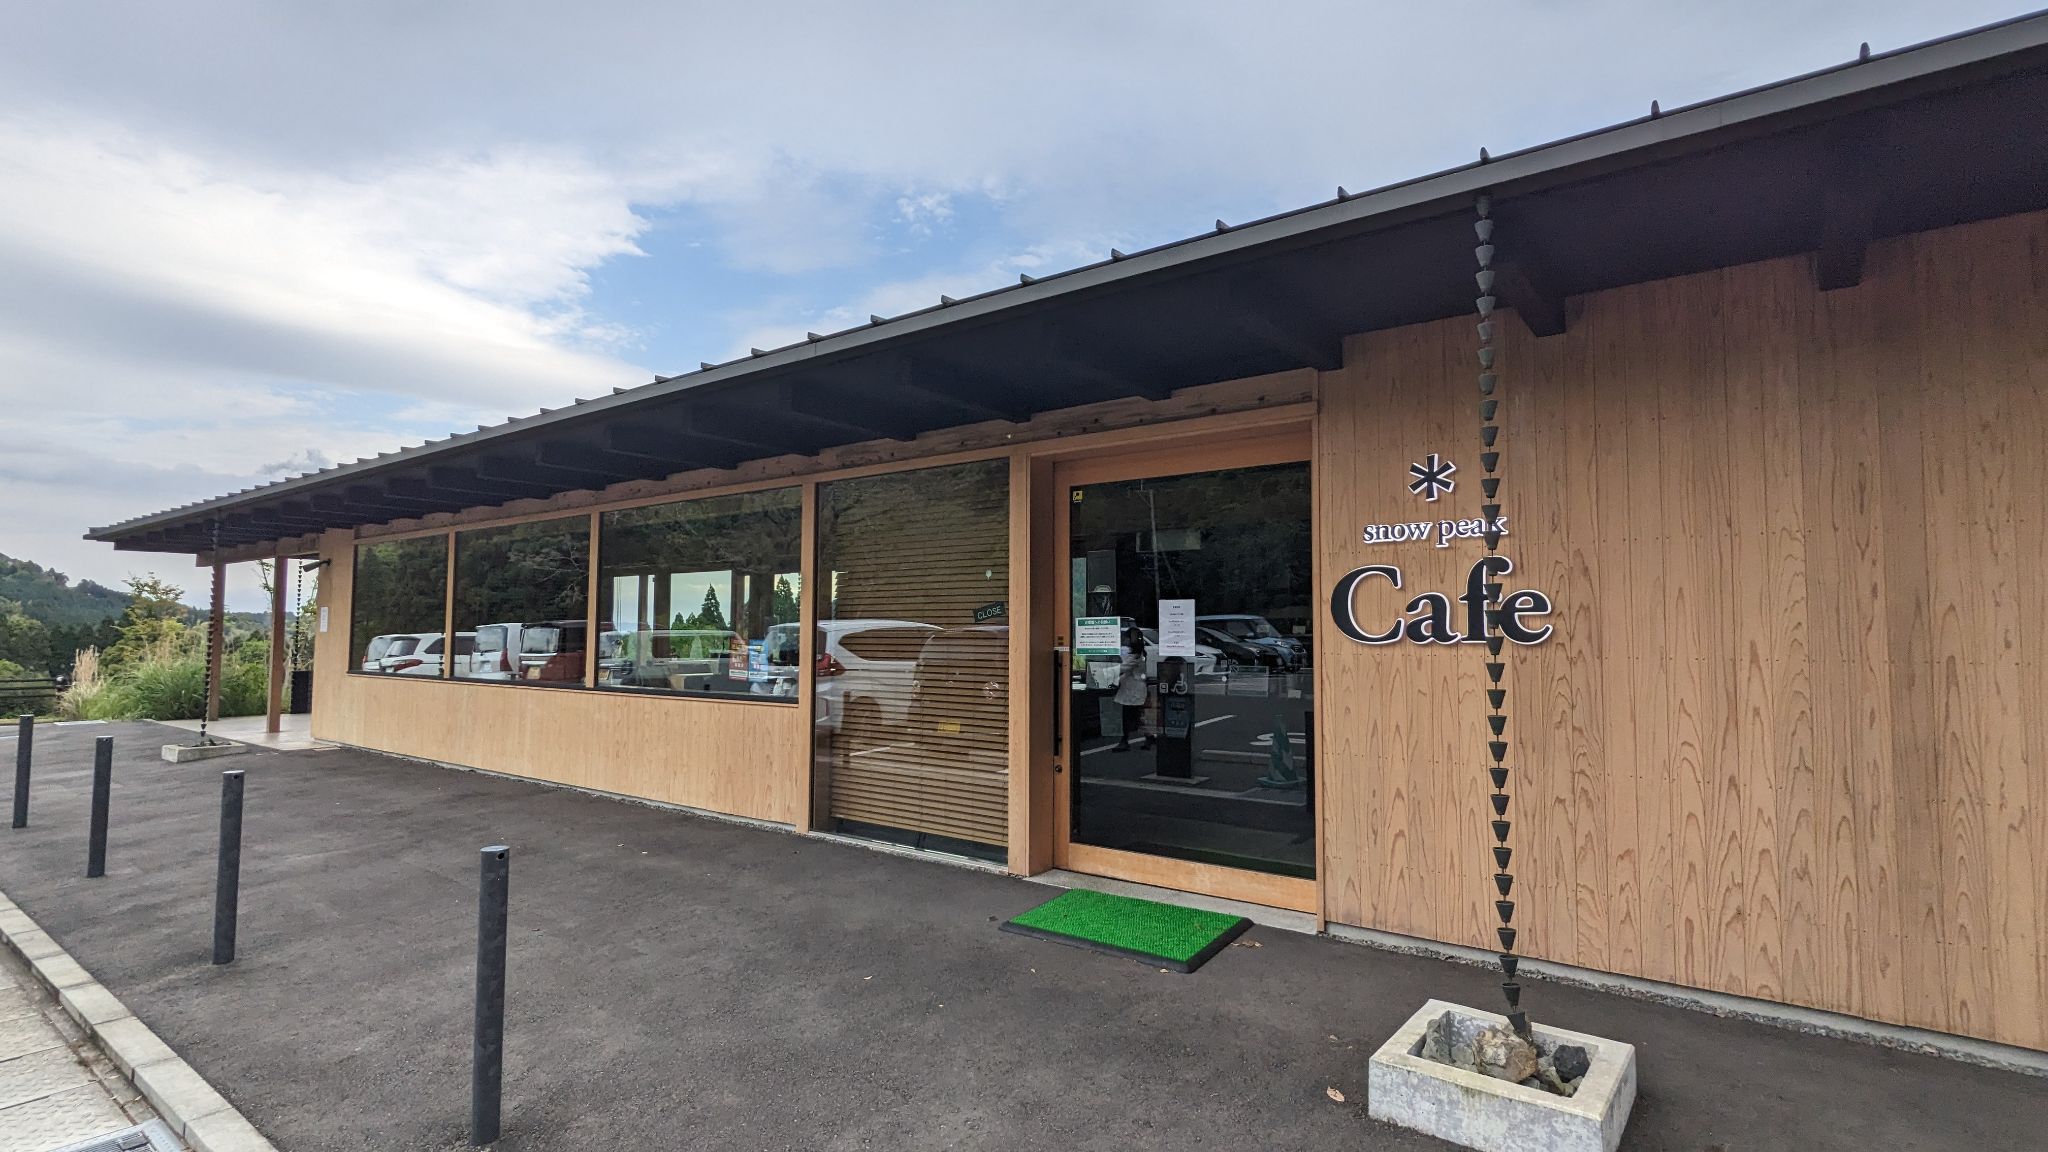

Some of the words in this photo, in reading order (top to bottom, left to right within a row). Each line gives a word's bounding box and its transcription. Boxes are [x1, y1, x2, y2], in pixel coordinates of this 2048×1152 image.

[1363, 521, 1431, 544] snow
[1331, 555, 1553, 645] Cafe
[977, 605, 1002, 619] CLOSE
